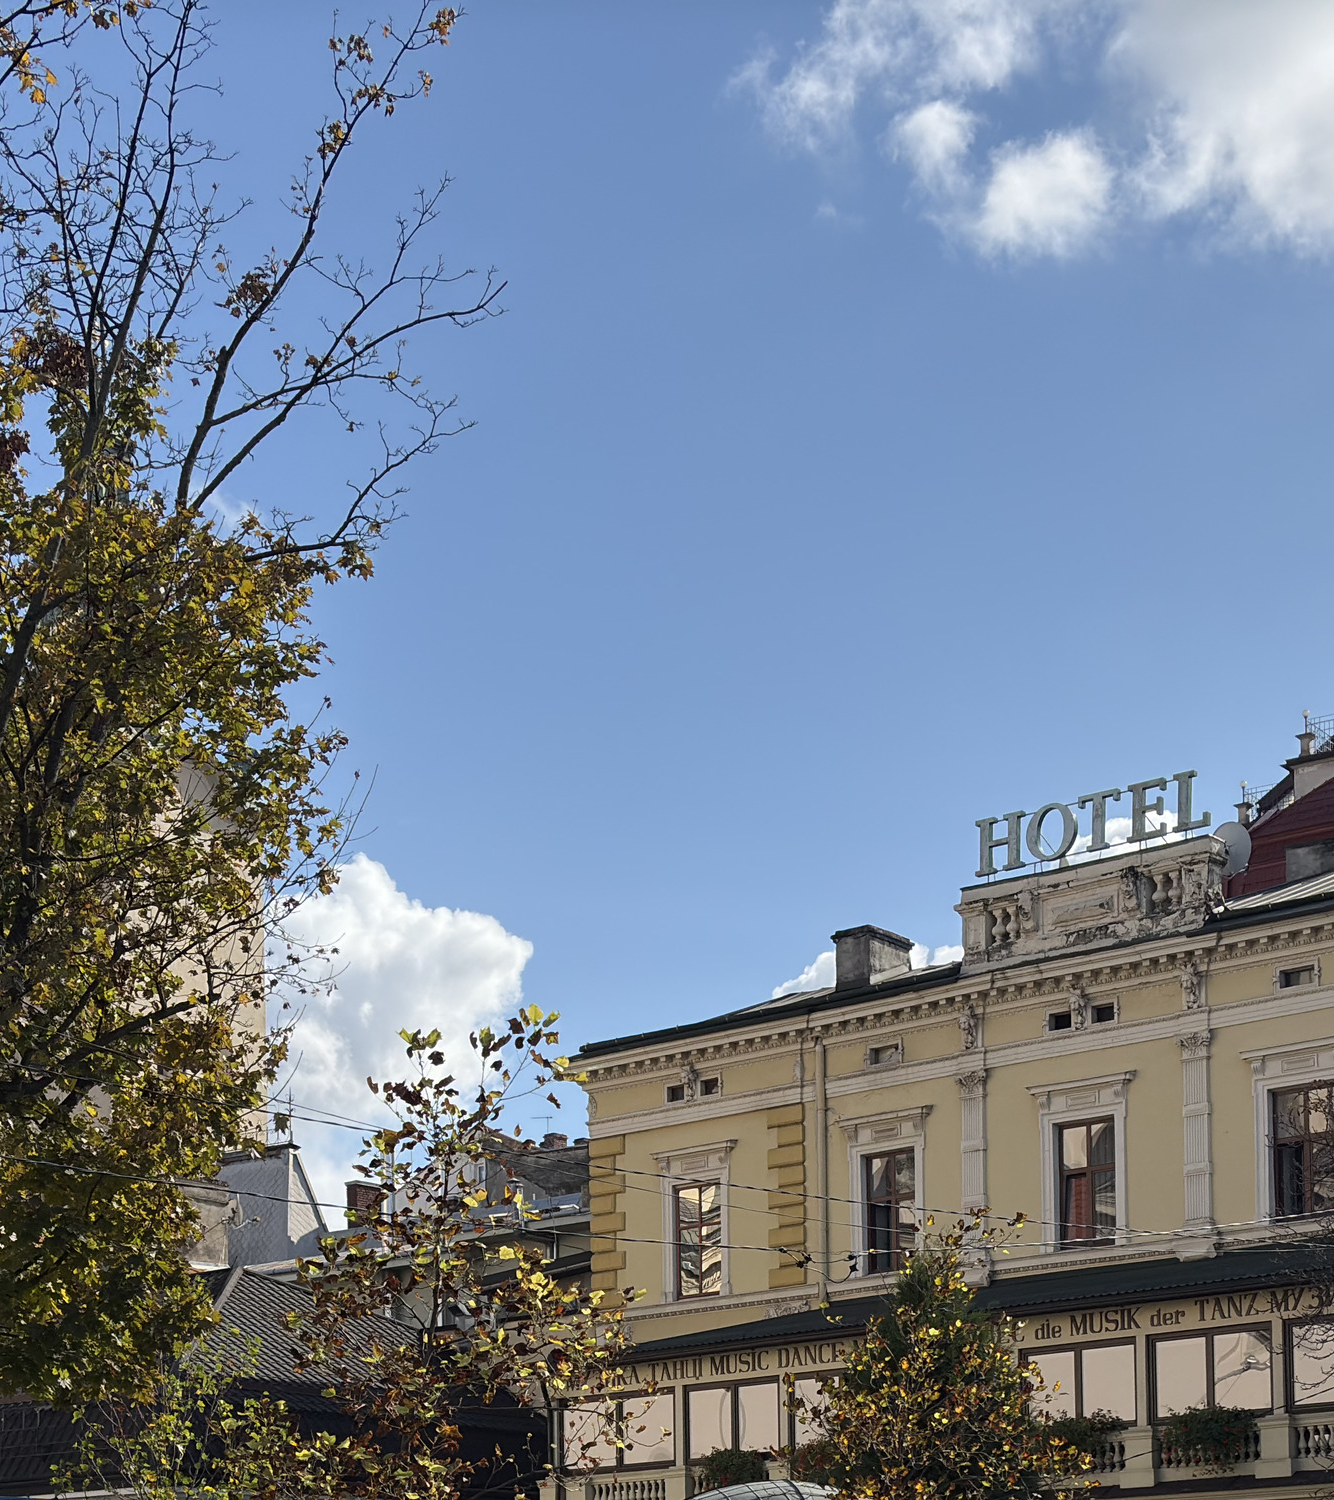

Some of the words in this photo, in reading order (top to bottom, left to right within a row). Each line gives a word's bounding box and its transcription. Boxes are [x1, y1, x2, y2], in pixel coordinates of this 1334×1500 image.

[975, 769, 1211, 877] HOTEL
[1034, 1319, 1062, 1341] die
[1069, 1306, 1142, 1337] MUSIK
[1150, 1307, 1186, 1327] der
[1195, 1292, 1260, 1322] TANZ
[709, 1349, 769, 1376] MUSIC
[776, 1341, 845, 1369] DANCE
